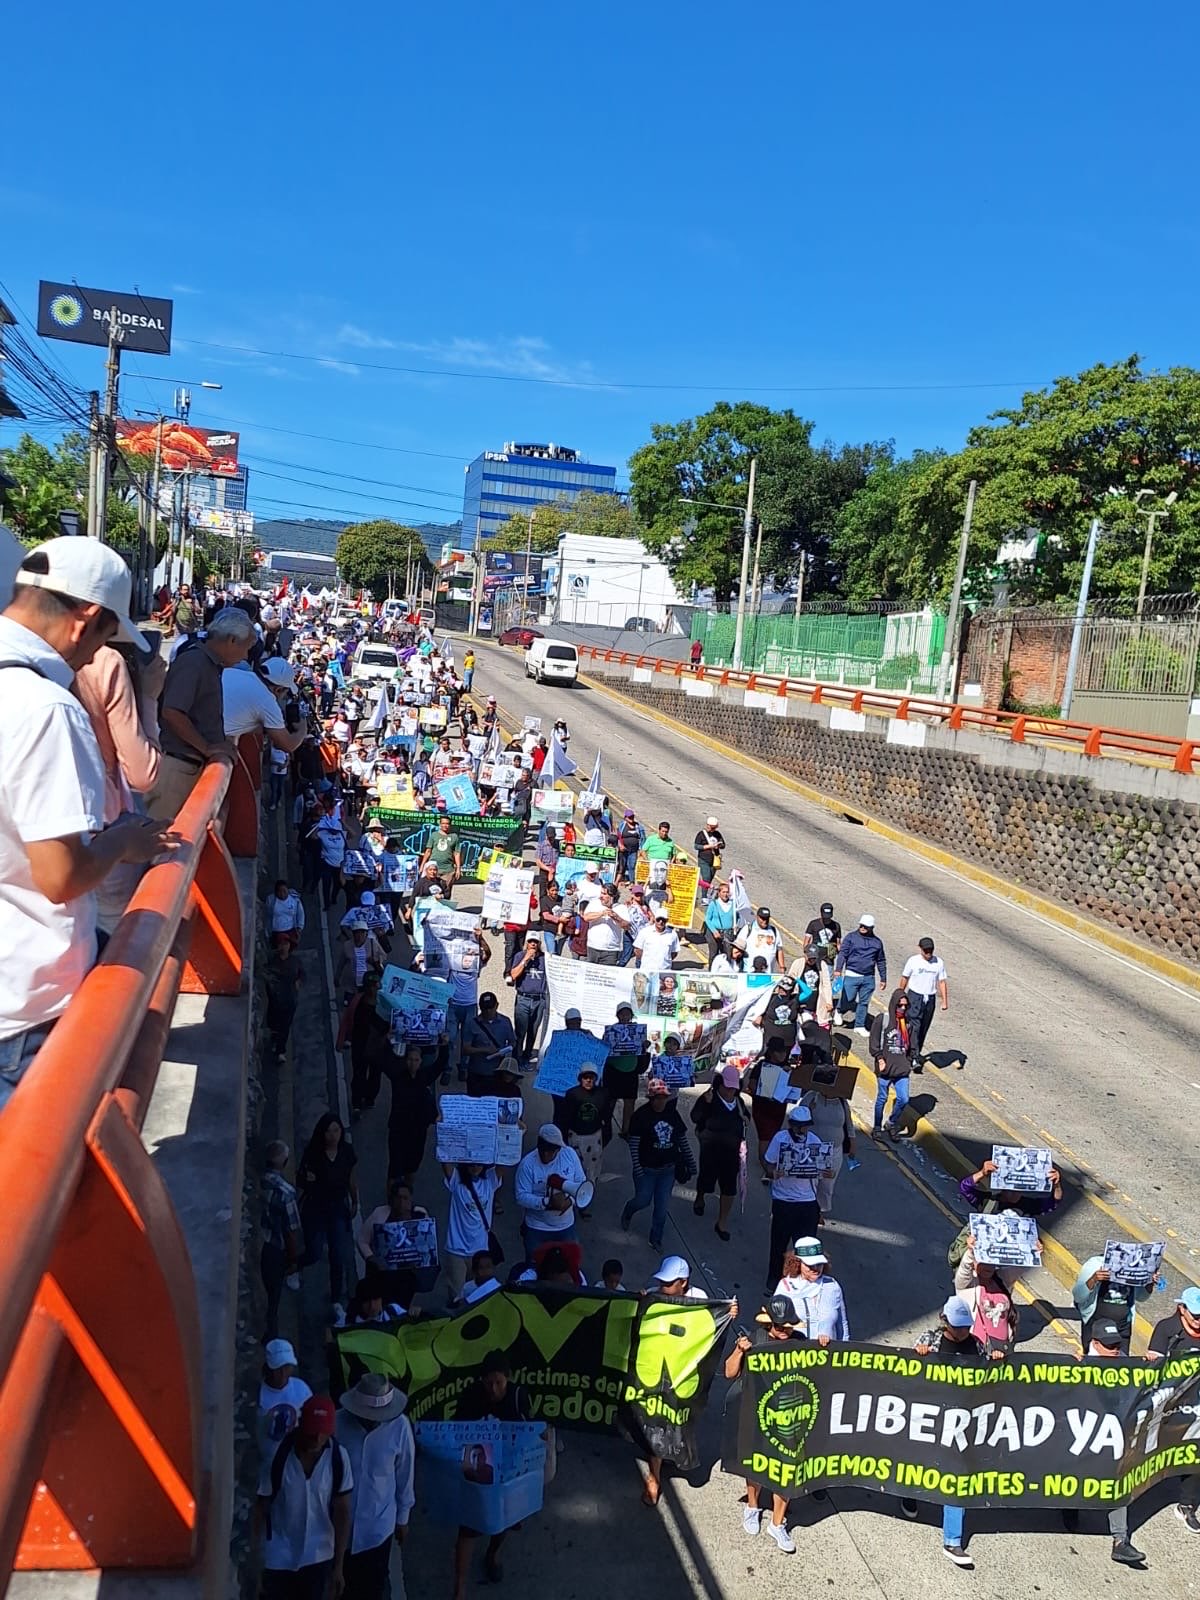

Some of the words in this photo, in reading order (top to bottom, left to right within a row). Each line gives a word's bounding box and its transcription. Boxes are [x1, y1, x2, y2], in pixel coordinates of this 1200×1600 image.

[747, 1350, 829, 1372] EXIJIMOS
[832, 1351, 922, 1377] LIBERTAD
[1017, 1364, 1032, 1384] A
[1034, 1364, 1130, 1388] NUESTR@S
[766, 1403, 812, 1427] MOVIR
[829, 1391, 1056, 1453] LIBERTAD
[896, 1462, 1025, 1497] INOCENTES
[1044, 1474, 1078, 1497] NO
